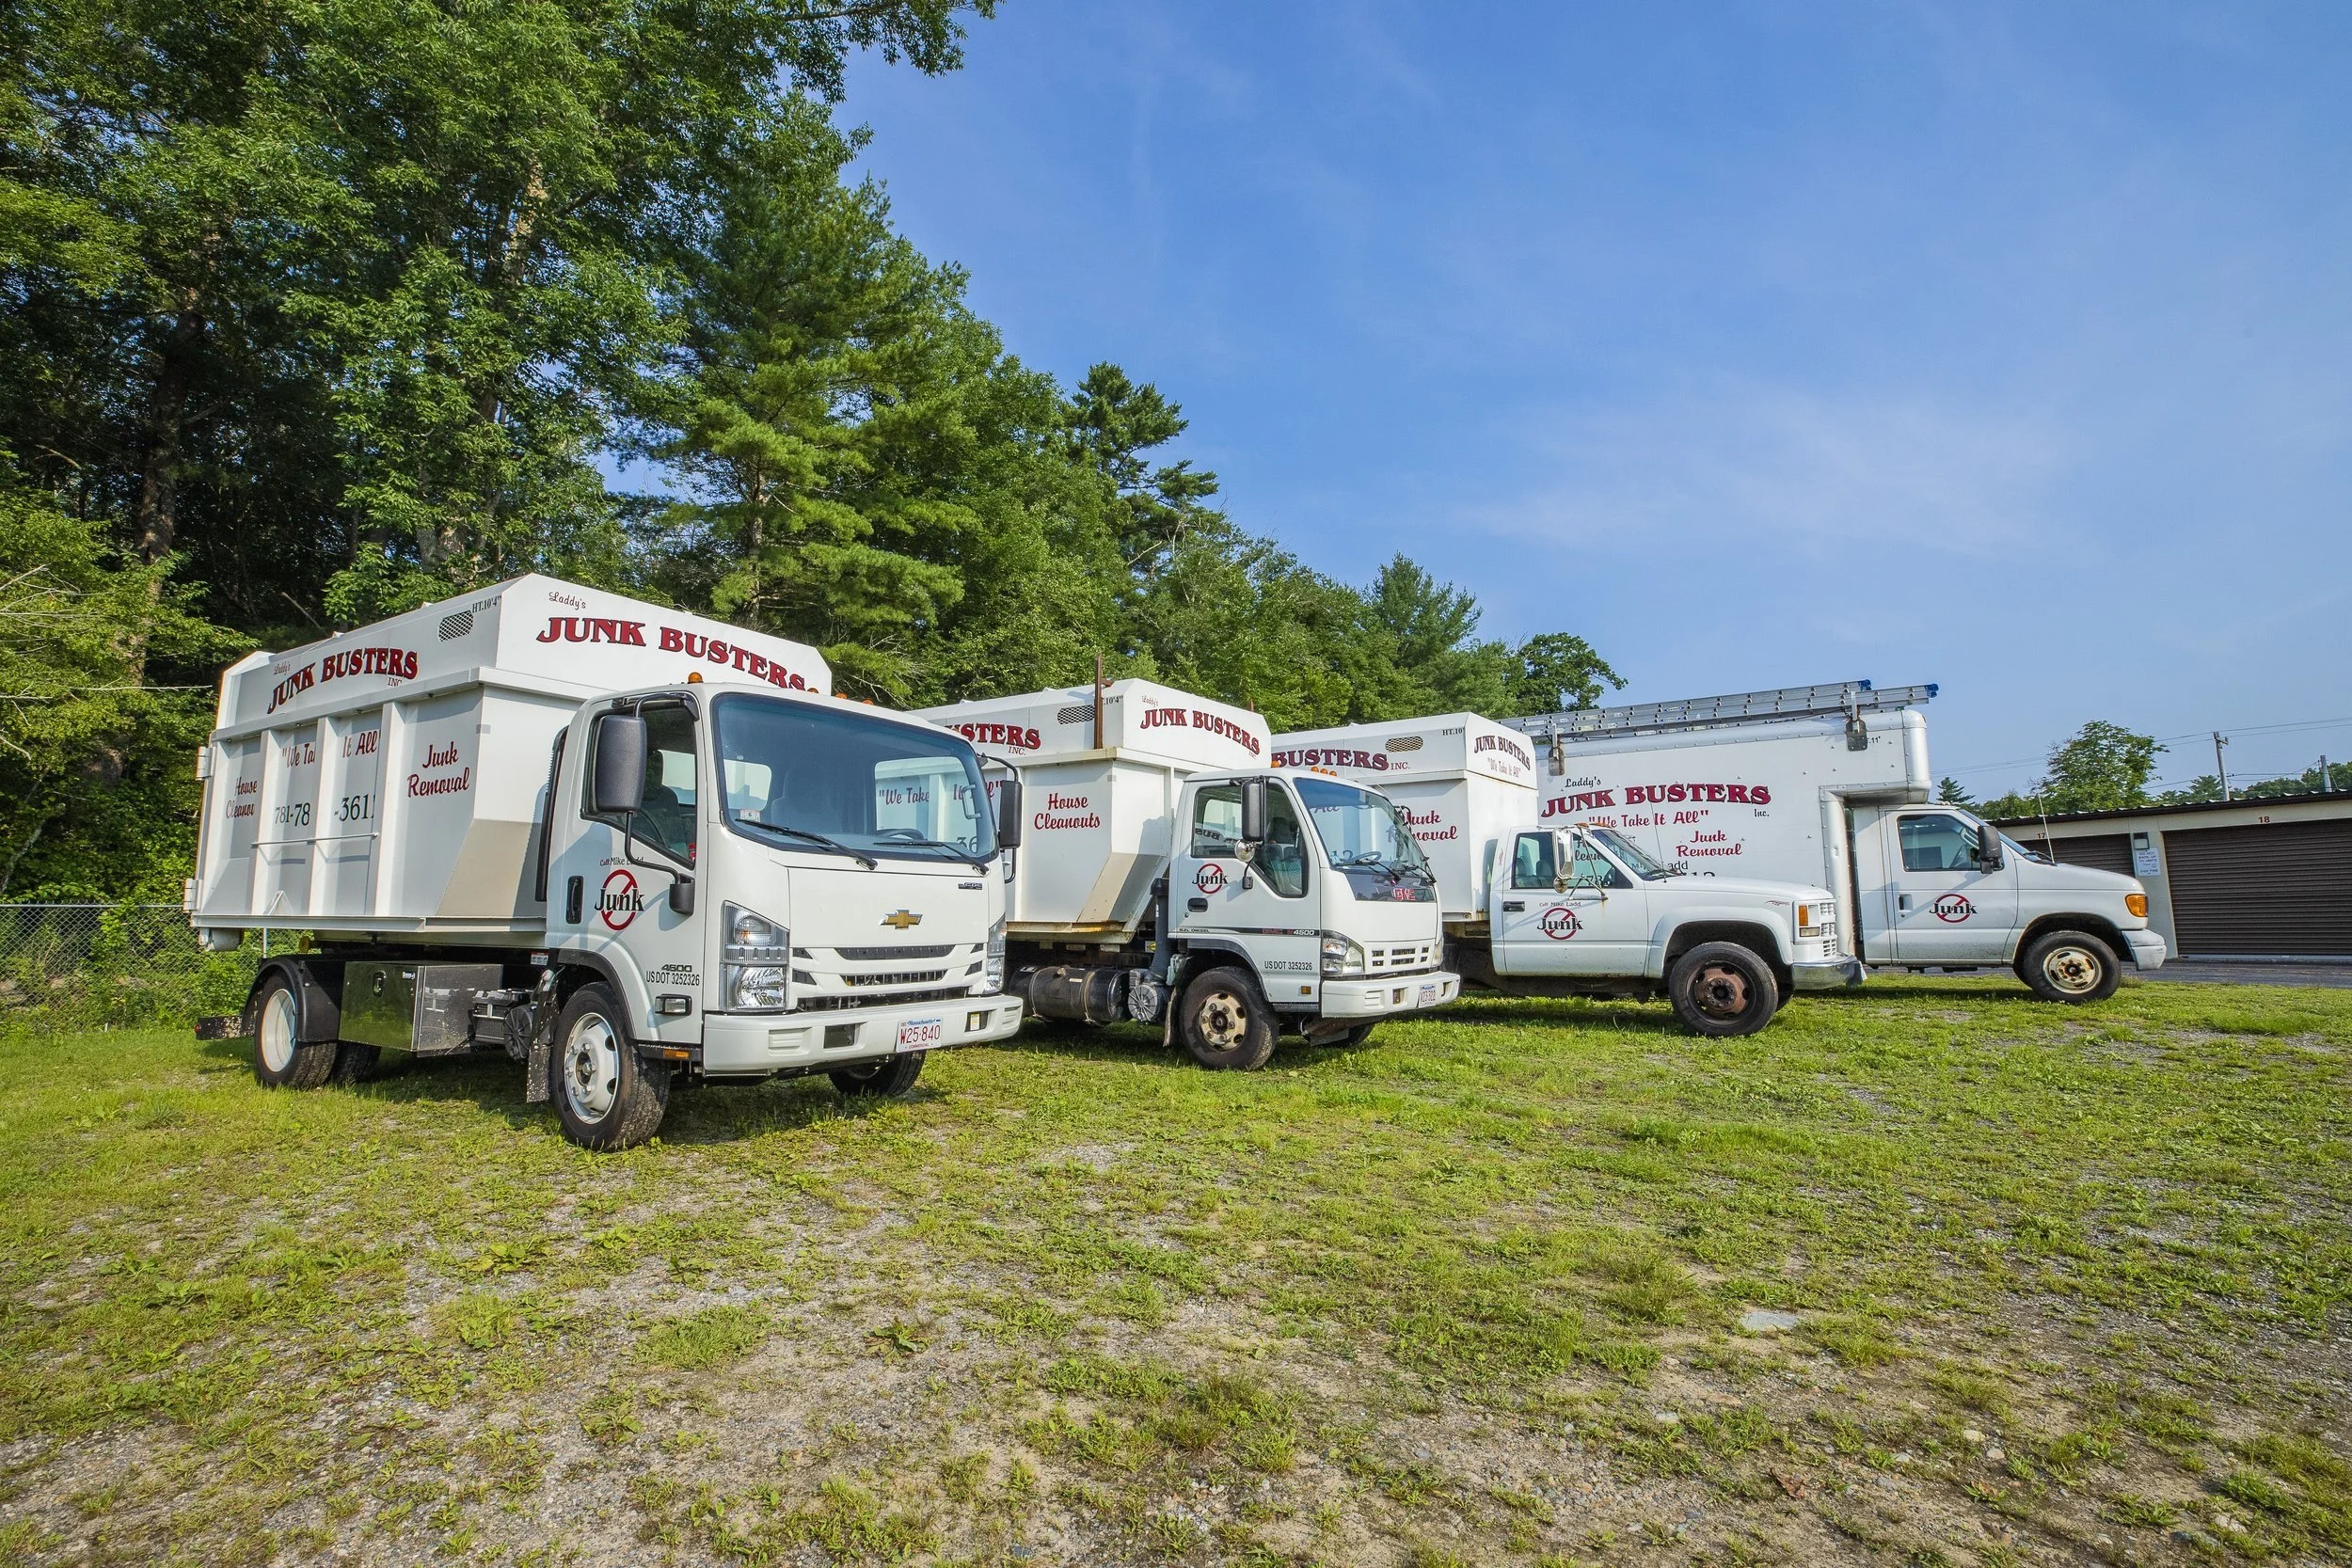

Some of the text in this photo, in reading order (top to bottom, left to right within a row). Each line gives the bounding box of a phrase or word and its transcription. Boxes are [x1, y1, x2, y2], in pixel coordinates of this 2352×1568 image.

[548, 592, 586, 610] Laddy's
[535, 617, 806, 691] JUNK BUSTERS
[267, 647, 418, 714] JUNK BUSTERS
[1140, 708, 1261, 755] JUNK BUSTERS
[303, 743, 316, 766] Ta
[342, 736, 351, 758] It
[422, 741, 458, 768] Junk
[1008, 745, 1026, 756] INC.
[1271, 749, 1410, 770] BUSTERS INC.
[1474, 736, 1530, 770] JUNK BUSTERS
[235, 776, 258, 797] House
[406, 767, 470, 798] Removal
[1565, 776, 1601, 788] Laddy's
[879, 788, 902, 805] "We
[906, 786, 930, 803] Take
[1047, 793, 1089, 811] House
[1541, 783, 1772, 817] JUNK BUSTERS
[1034, 812, 1101, 830] Cleanouts
[1621, 812, 1649, 828] Take
[1654, 813, 1666, 825] It
[1673, 809, 1708, 825] All"
[1754, 808, 1770, 817] Inc.
[1690, 830, 1727, 843] Junk
[1676, 843, 1743, 858] Removal
[611, 856, 626, 866] Mike
[1192, 873, 1229, 885] Junk
[595, 889, 644, 911] Junk
[1929, 902, 1978, 914] Junk
[1536, 917, 1583, 930] Junk
[1288, 961, 1313, 971] 3252326
[671, 973, 700, 987] 3252326
